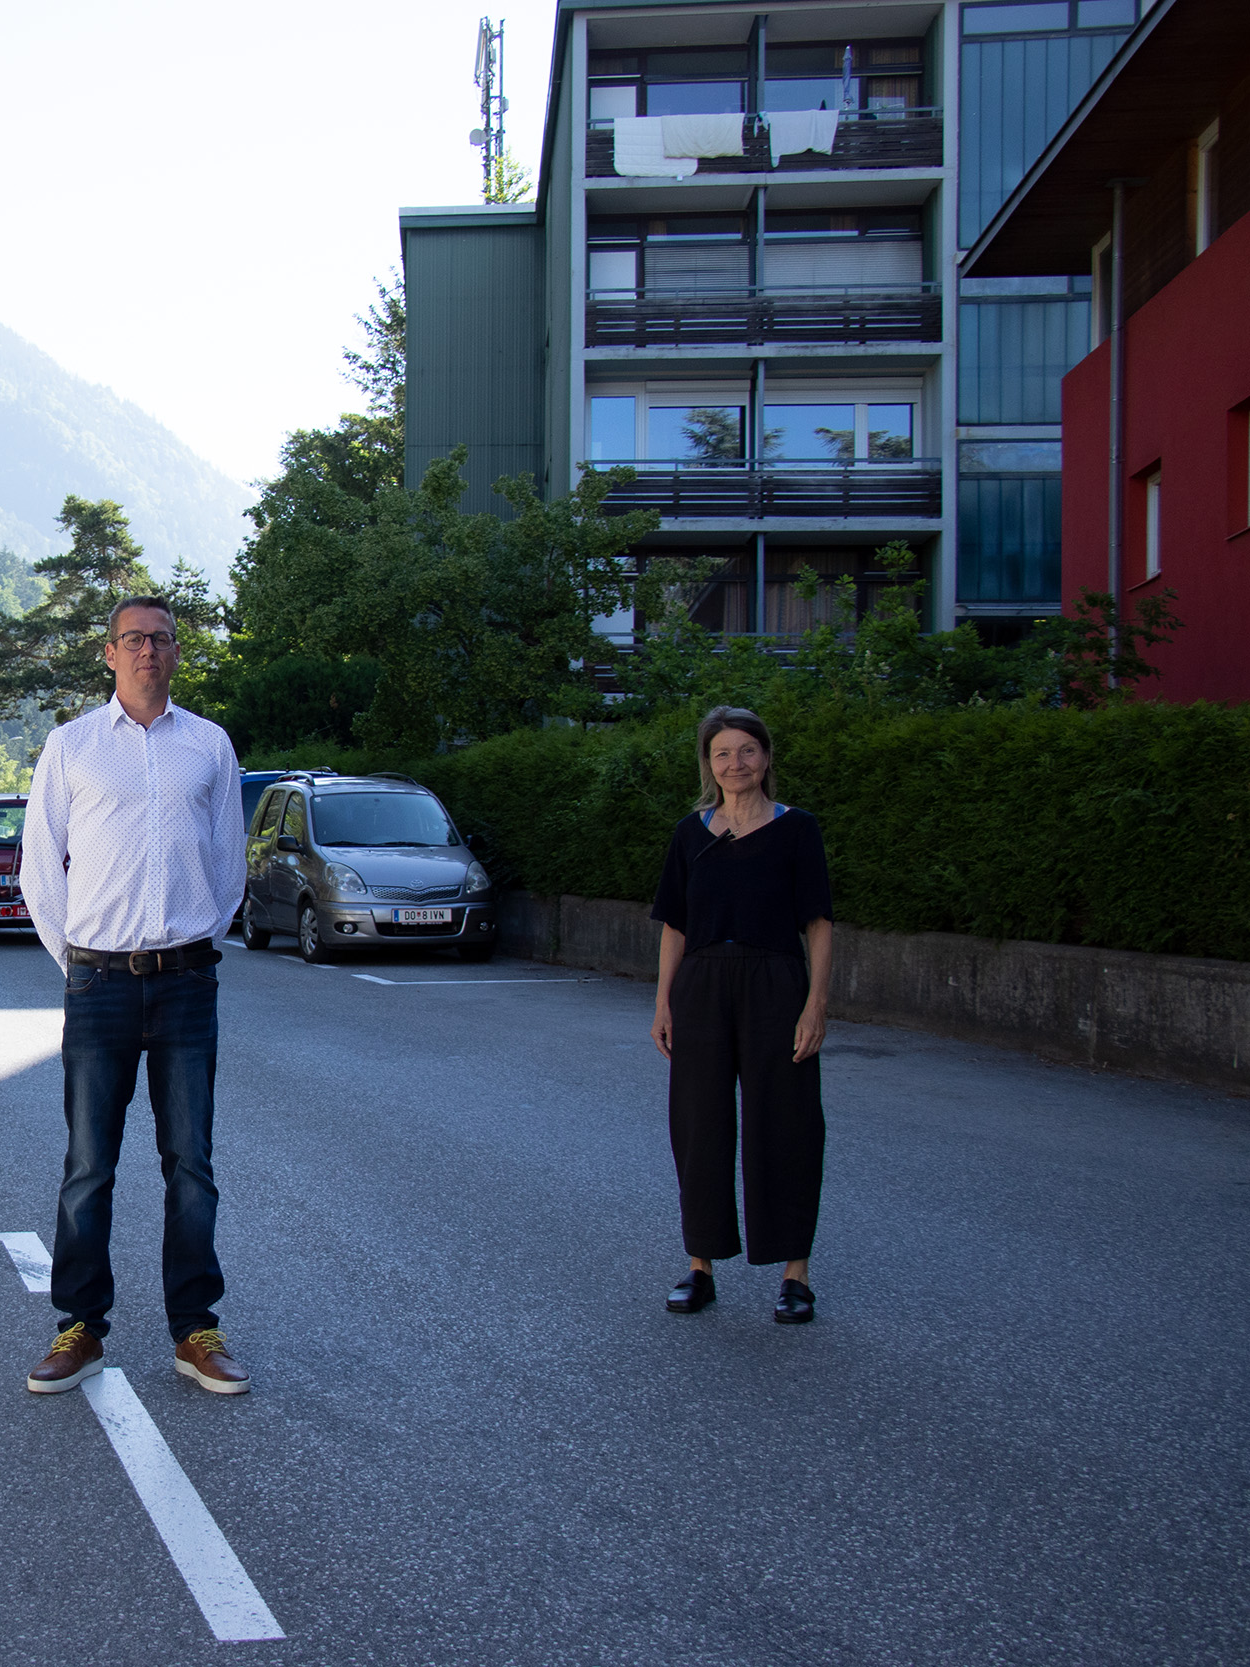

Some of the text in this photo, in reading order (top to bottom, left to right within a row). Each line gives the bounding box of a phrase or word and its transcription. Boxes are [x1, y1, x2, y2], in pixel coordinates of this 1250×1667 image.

[404, 910, 445, 920] DO 8 IVN
